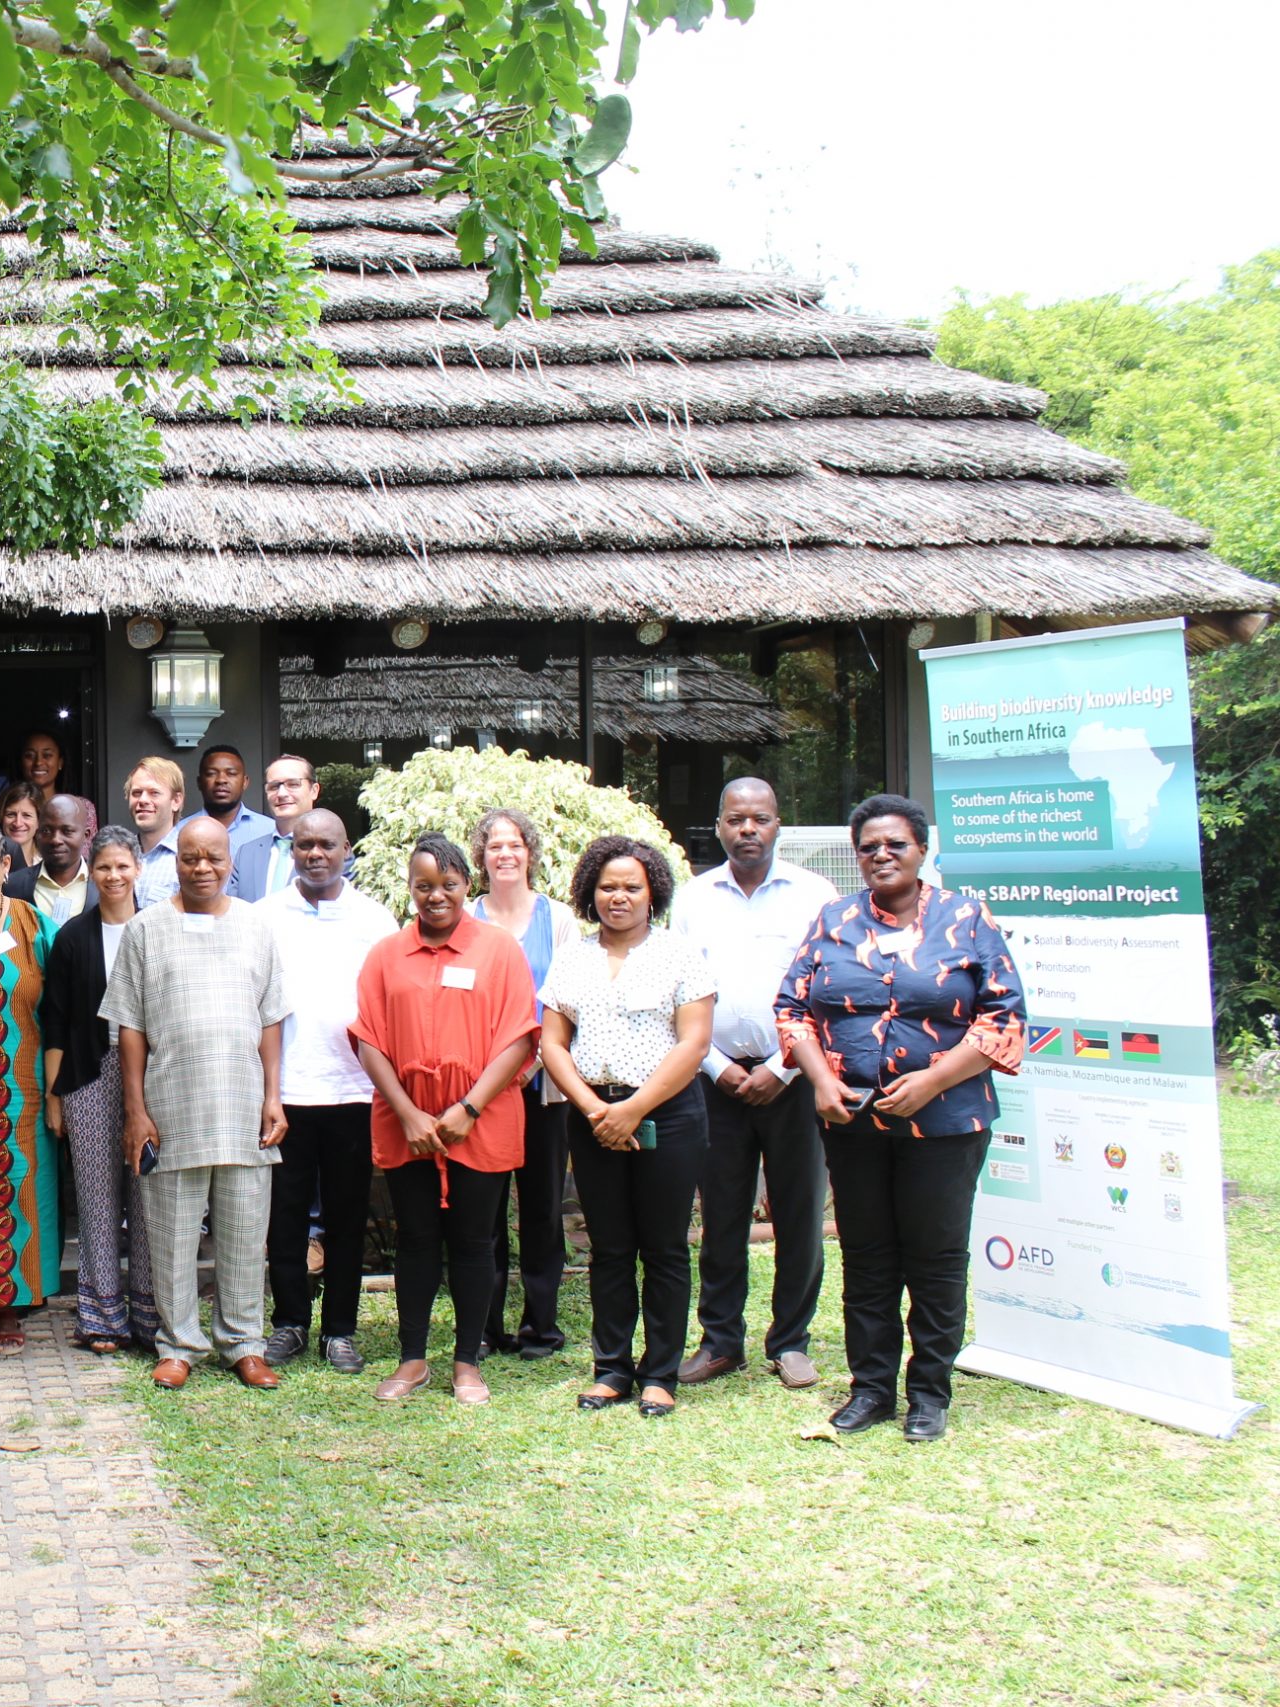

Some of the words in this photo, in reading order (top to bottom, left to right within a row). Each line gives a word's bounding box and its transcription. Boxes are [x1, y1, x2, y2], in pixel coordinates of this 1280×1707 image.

[941, 704, 997, 722] Building
[1000, 692, 1083, 716] biodiversity
[1086, 684, 1173, 709] knowledge
[948, 732, 959, 746] in
[963, 726, 1024, 745] Southern
[1028, 723, 1066, 740] Africa
[951, 793, 1005, 808] Southern
[1009, 791, 1043, 805] Africa
[1045, 790, 1056, 803] is
[1058, 788, 1094, 803] home
[952, 814, 965, 826] to
[967, 815, 1000, 825] some
[1002, 811, 1016, 824] of
[1018, 811, 1038, 823] the
[1040, 809, 1082, 823] richest
[954, 831, 1022, 847] ecosystems
[1024, 830, 1037, 842] in
[1039, 828, 1059, 841] the
[1062, 827, 1098, 841] world
[959, 885, 986, 901] The
[989, 886, 1040, 901] SBAPP
[1043, 886, 1112, 905] Regional
[1115, 885, 1179, 906] Project
[1034, 935, 1063, 947] Spatial
[1065, 936, 1119, 949] Biodiversity
[1121, 938, 1180, 950] Assessment
[1036, 961, 1091, 973] Prioritisation
[1038, 988, 1076, 1002] Planning
[1034, 1066, 1071, 1079] Namibia,
[1072, 1069, 1131, 1086] Mozambique
[1133, 1075, 1151, 1086] and
[1152, 1078, 1187, 1089] Malawi
[1111, 1205, 1127, 1213] WCS
[1018, 1245, 1054, 1266] AFD
